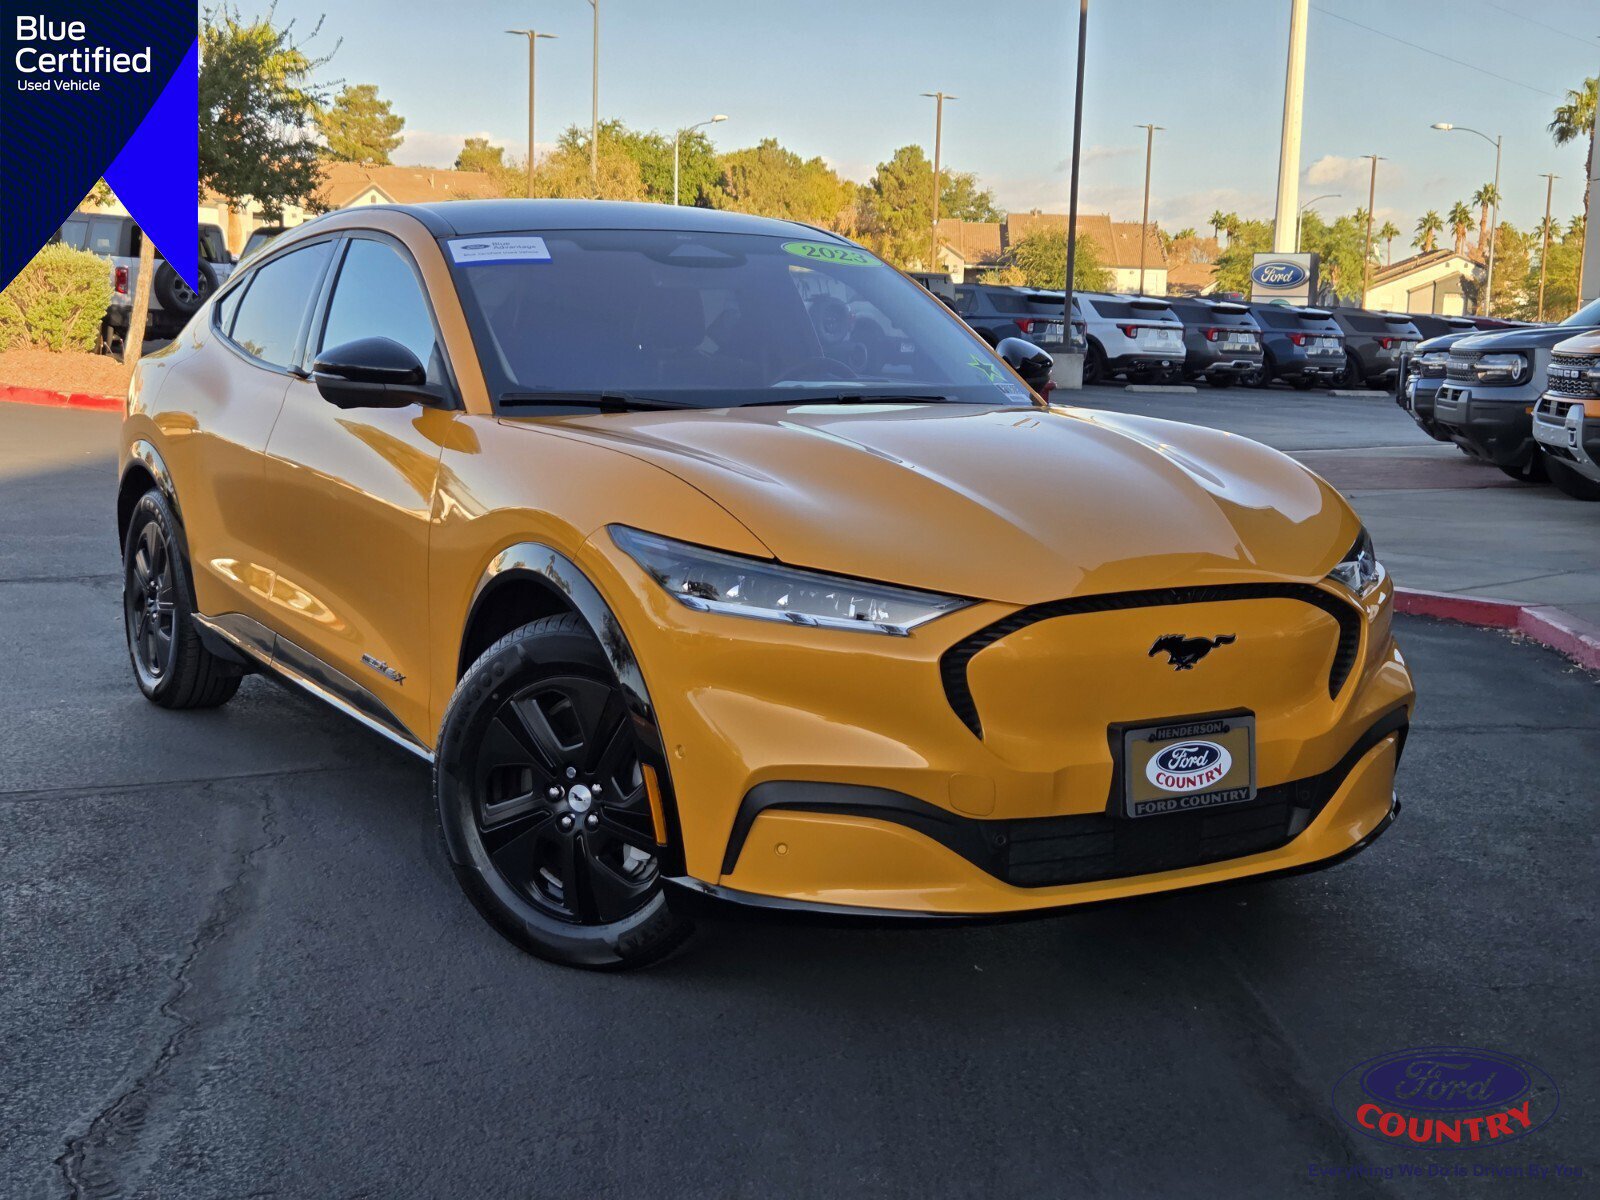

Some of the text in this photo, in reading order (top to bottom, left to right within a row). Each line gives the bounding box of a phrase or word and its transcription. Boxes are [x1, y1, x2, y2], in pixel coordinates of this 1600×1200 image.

[802, 245, 868, 264] 2023
[1260, 265, 1294, 283] Ford
[1157, 722, 1222, 740] HENDERSON
[1167, 746, 1210, 770] Ford
[1155, 763, 1223, 789] COUNTRY
[1137, 788, 1249, 815] FORD COUNTRY
